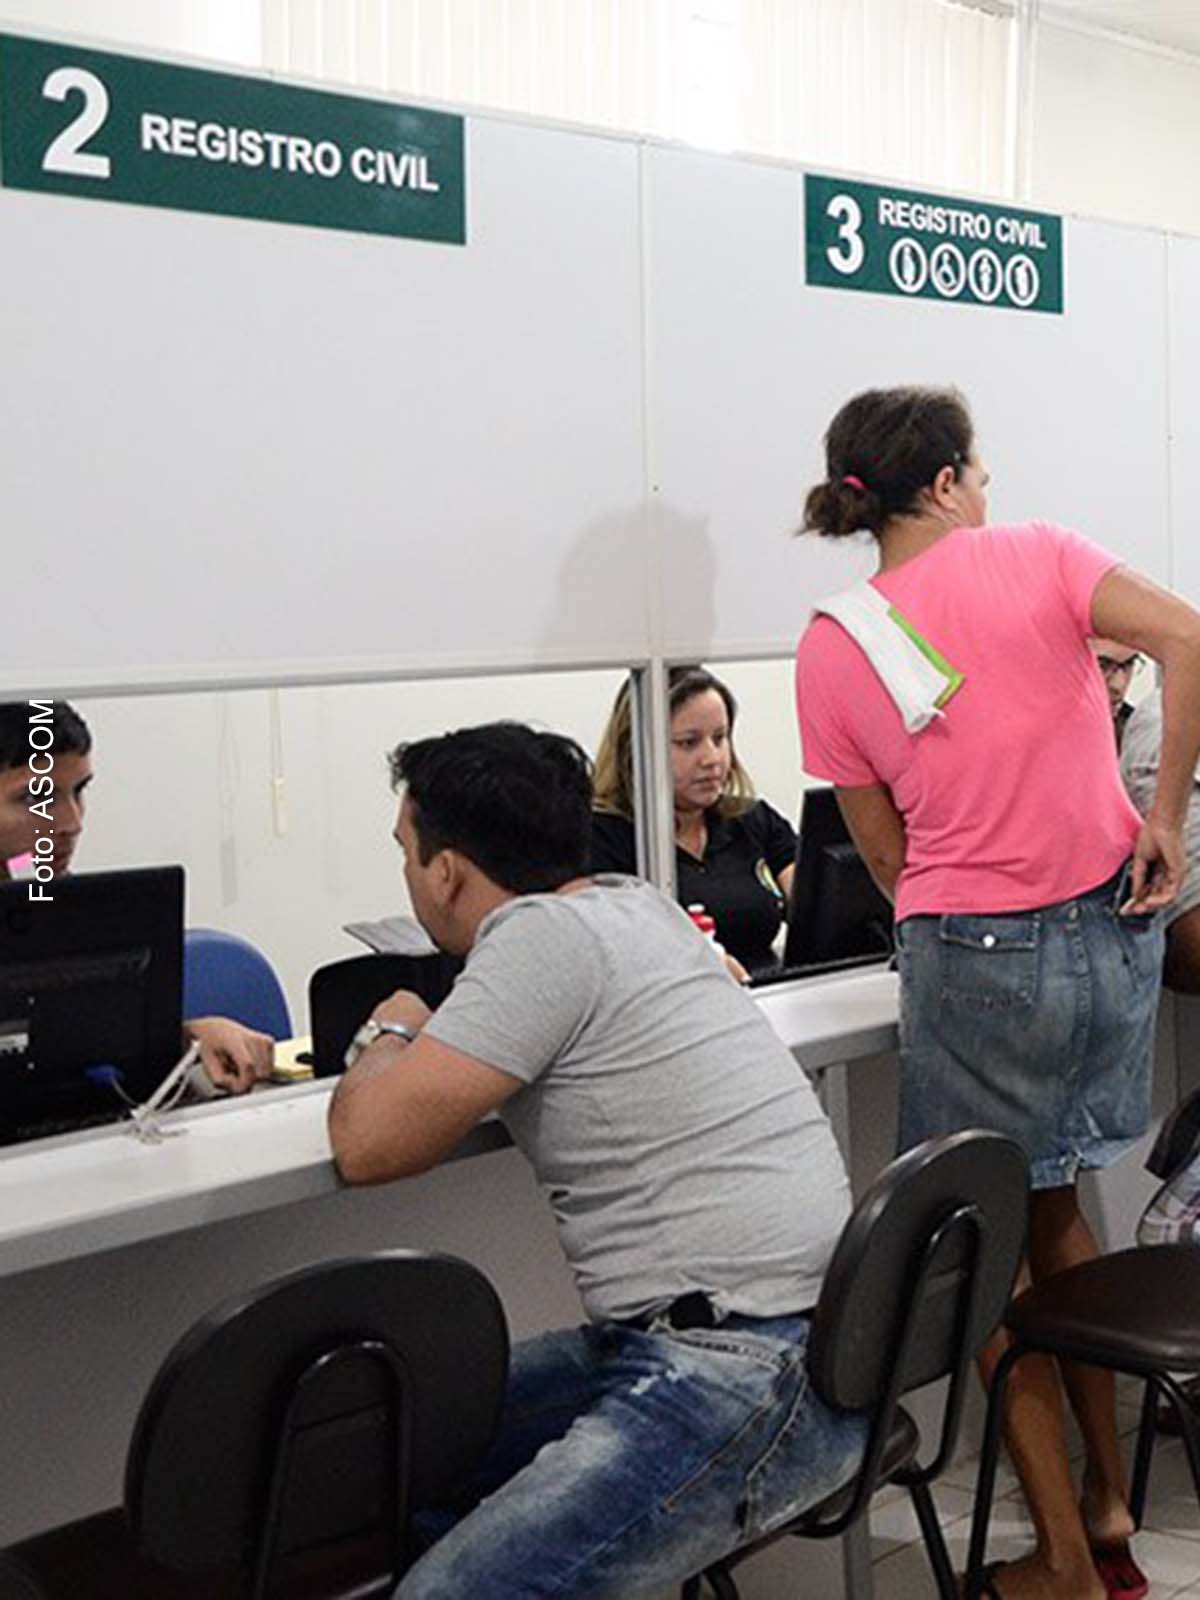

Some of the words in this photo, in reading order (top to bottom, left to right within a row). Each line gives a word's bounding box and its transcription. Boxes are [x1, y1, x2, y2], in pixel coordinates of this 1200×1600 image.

[42, 66, 110, 178] 2
[140, 112, 342, 177] REGISTRO
[351, 147, 440, 191] CIVIL
[826, 194, 864, 275] 3
[878, 198, 991, 240] REGISTRO
[995, 217, 1047, 249] CIVIL
